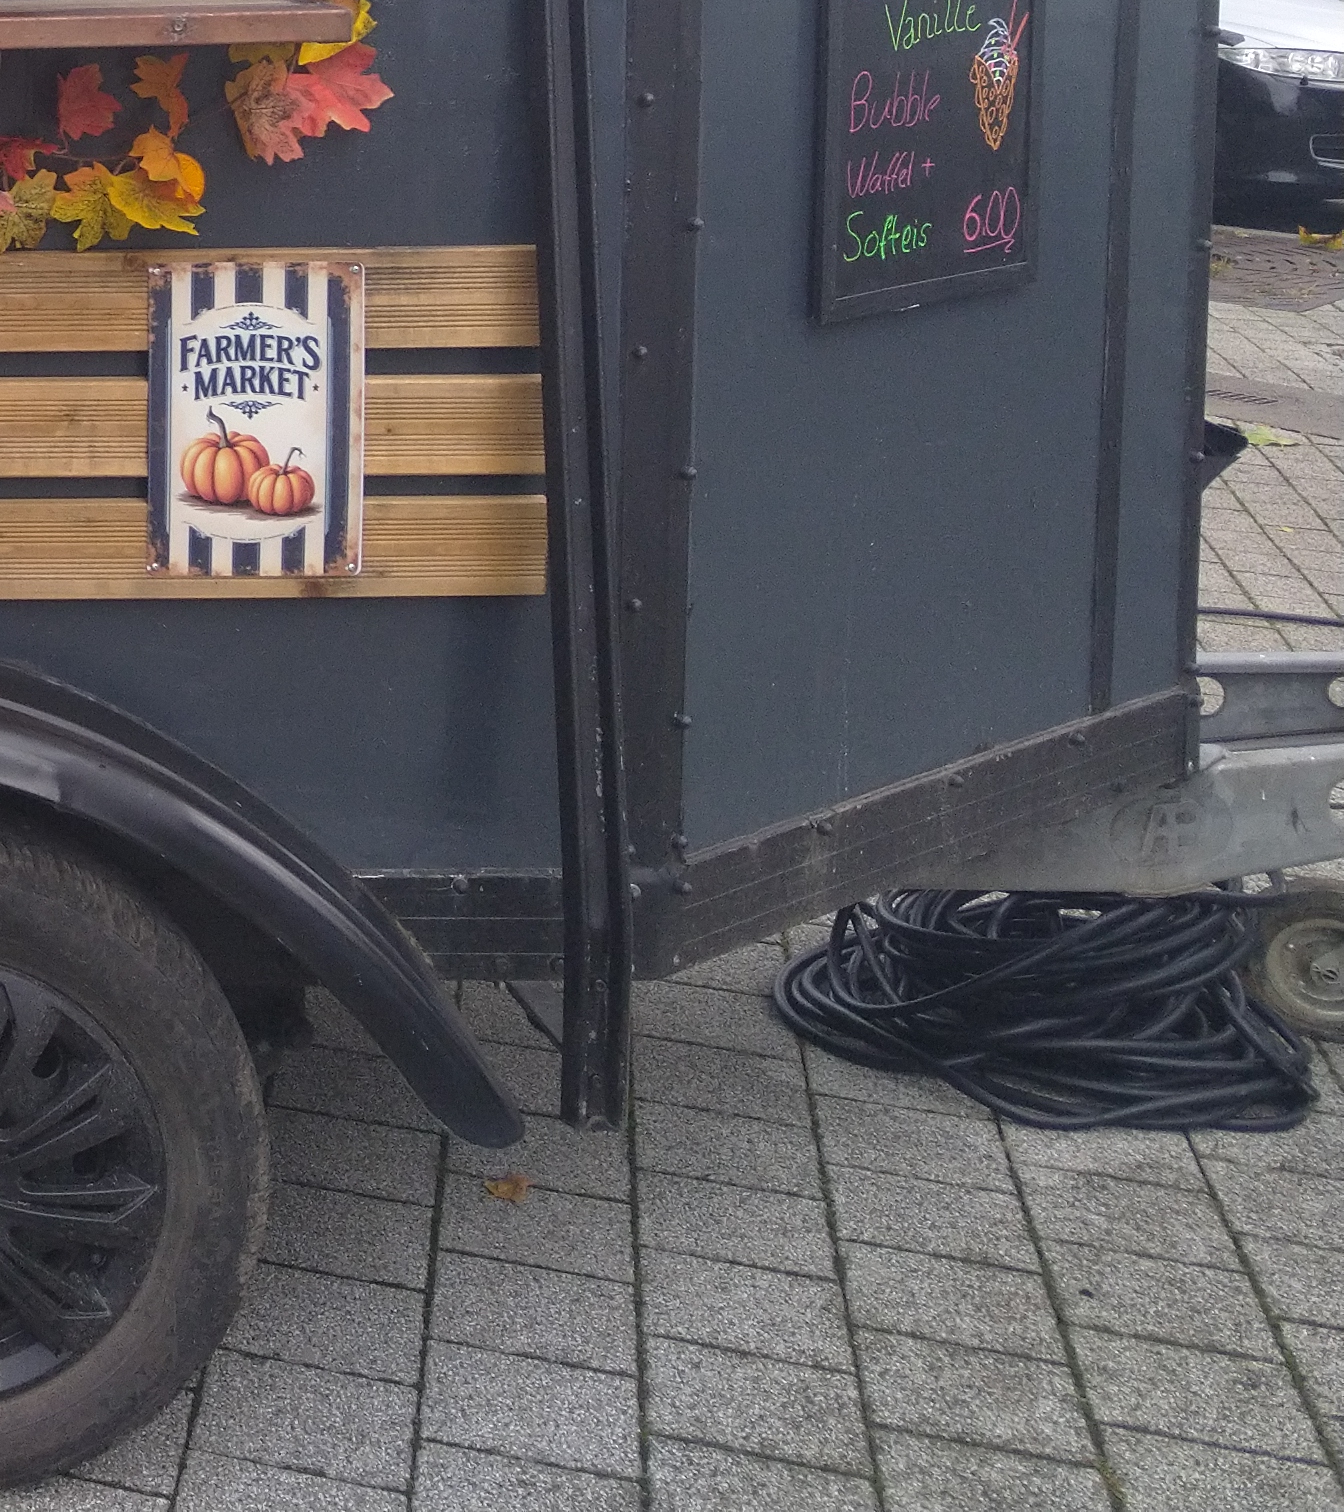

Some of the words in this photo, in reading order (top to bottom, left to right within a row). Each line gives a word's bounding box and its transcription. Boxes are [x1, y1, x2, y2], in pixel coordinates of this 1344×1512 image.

[848, 69, 941, 134] Bubble
[847, 150, 915, 199] Waffel
[843, 210, 933, 262] Softeis
[178, 333, 323, 374] FARMER'S
[193, 365, 311, 402] MARKET
